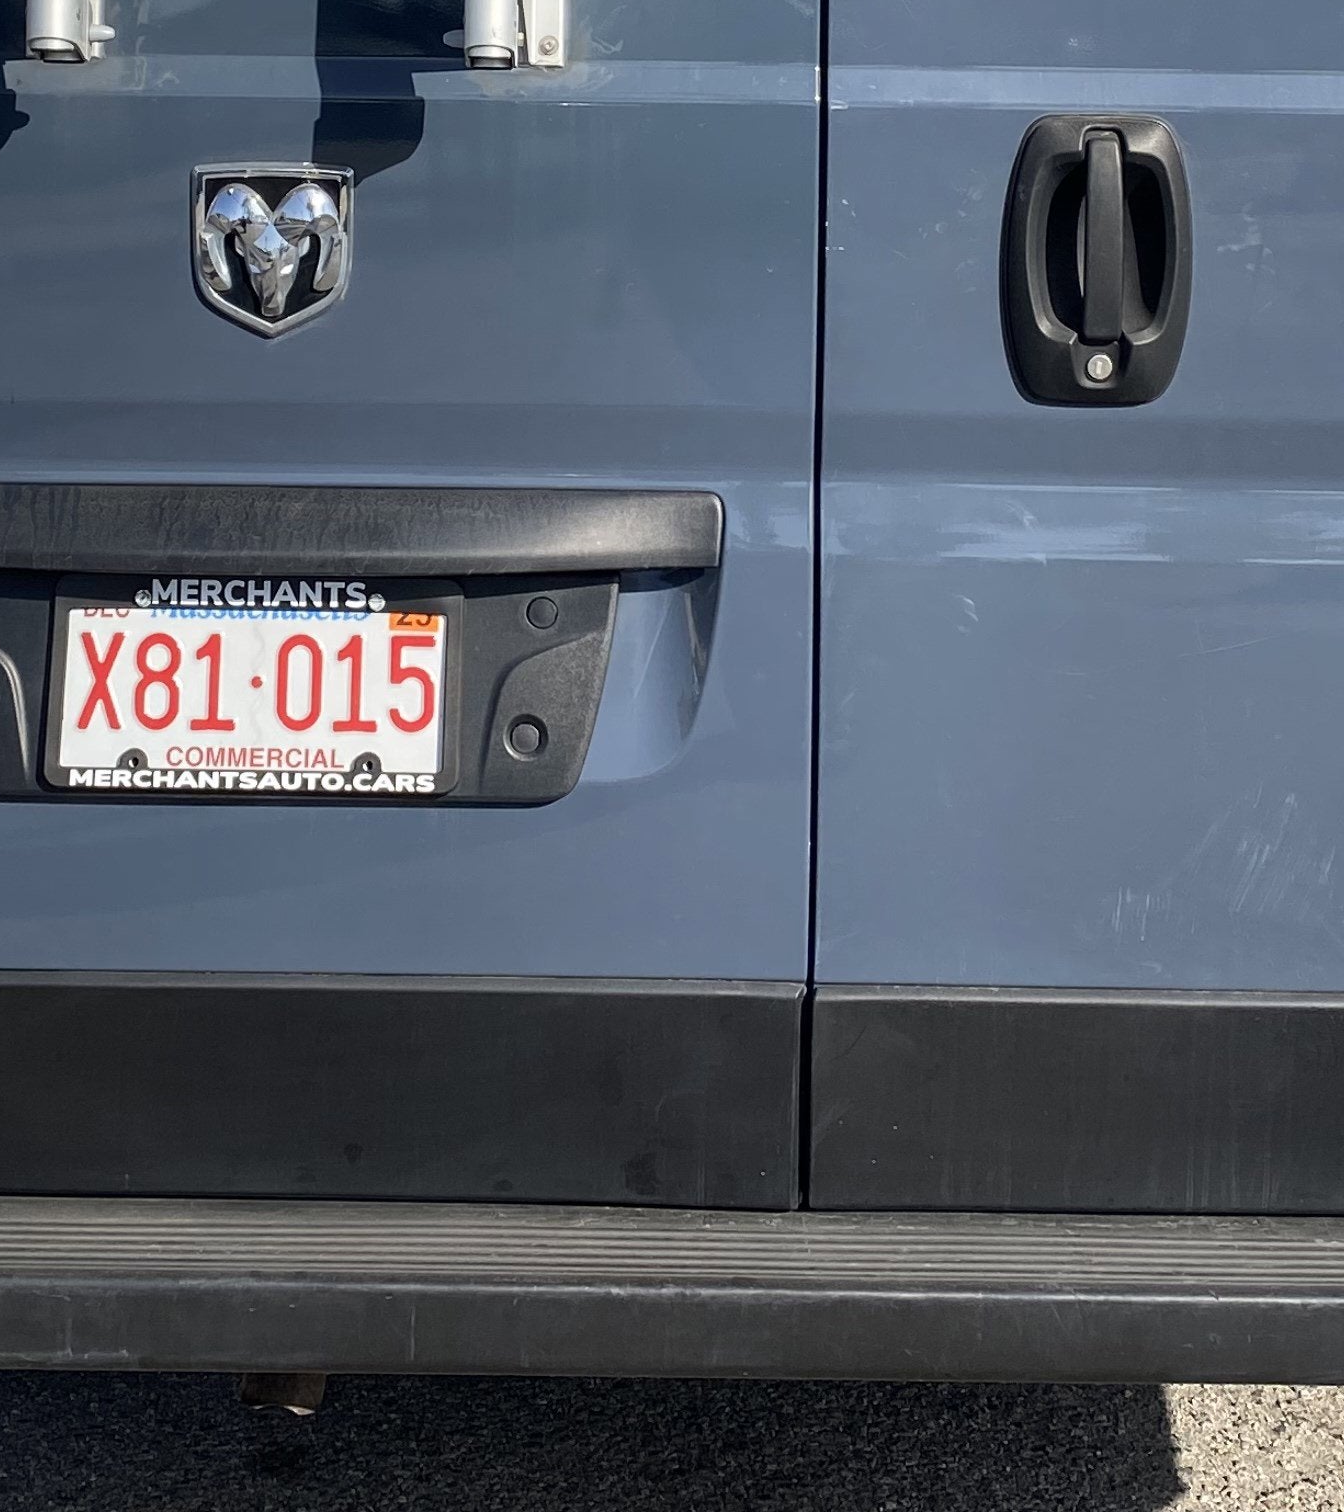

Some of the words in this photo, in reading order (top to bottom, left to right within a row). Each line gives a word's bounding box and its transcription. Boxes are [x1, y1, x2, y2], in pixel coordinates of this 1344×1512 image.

[151, 578, 367, 609] MERCHANTS
[166, 746, 345, 769] COMMERCIAL
[68, 768, 436, 793] MERCHANTSAUTO.CARS
